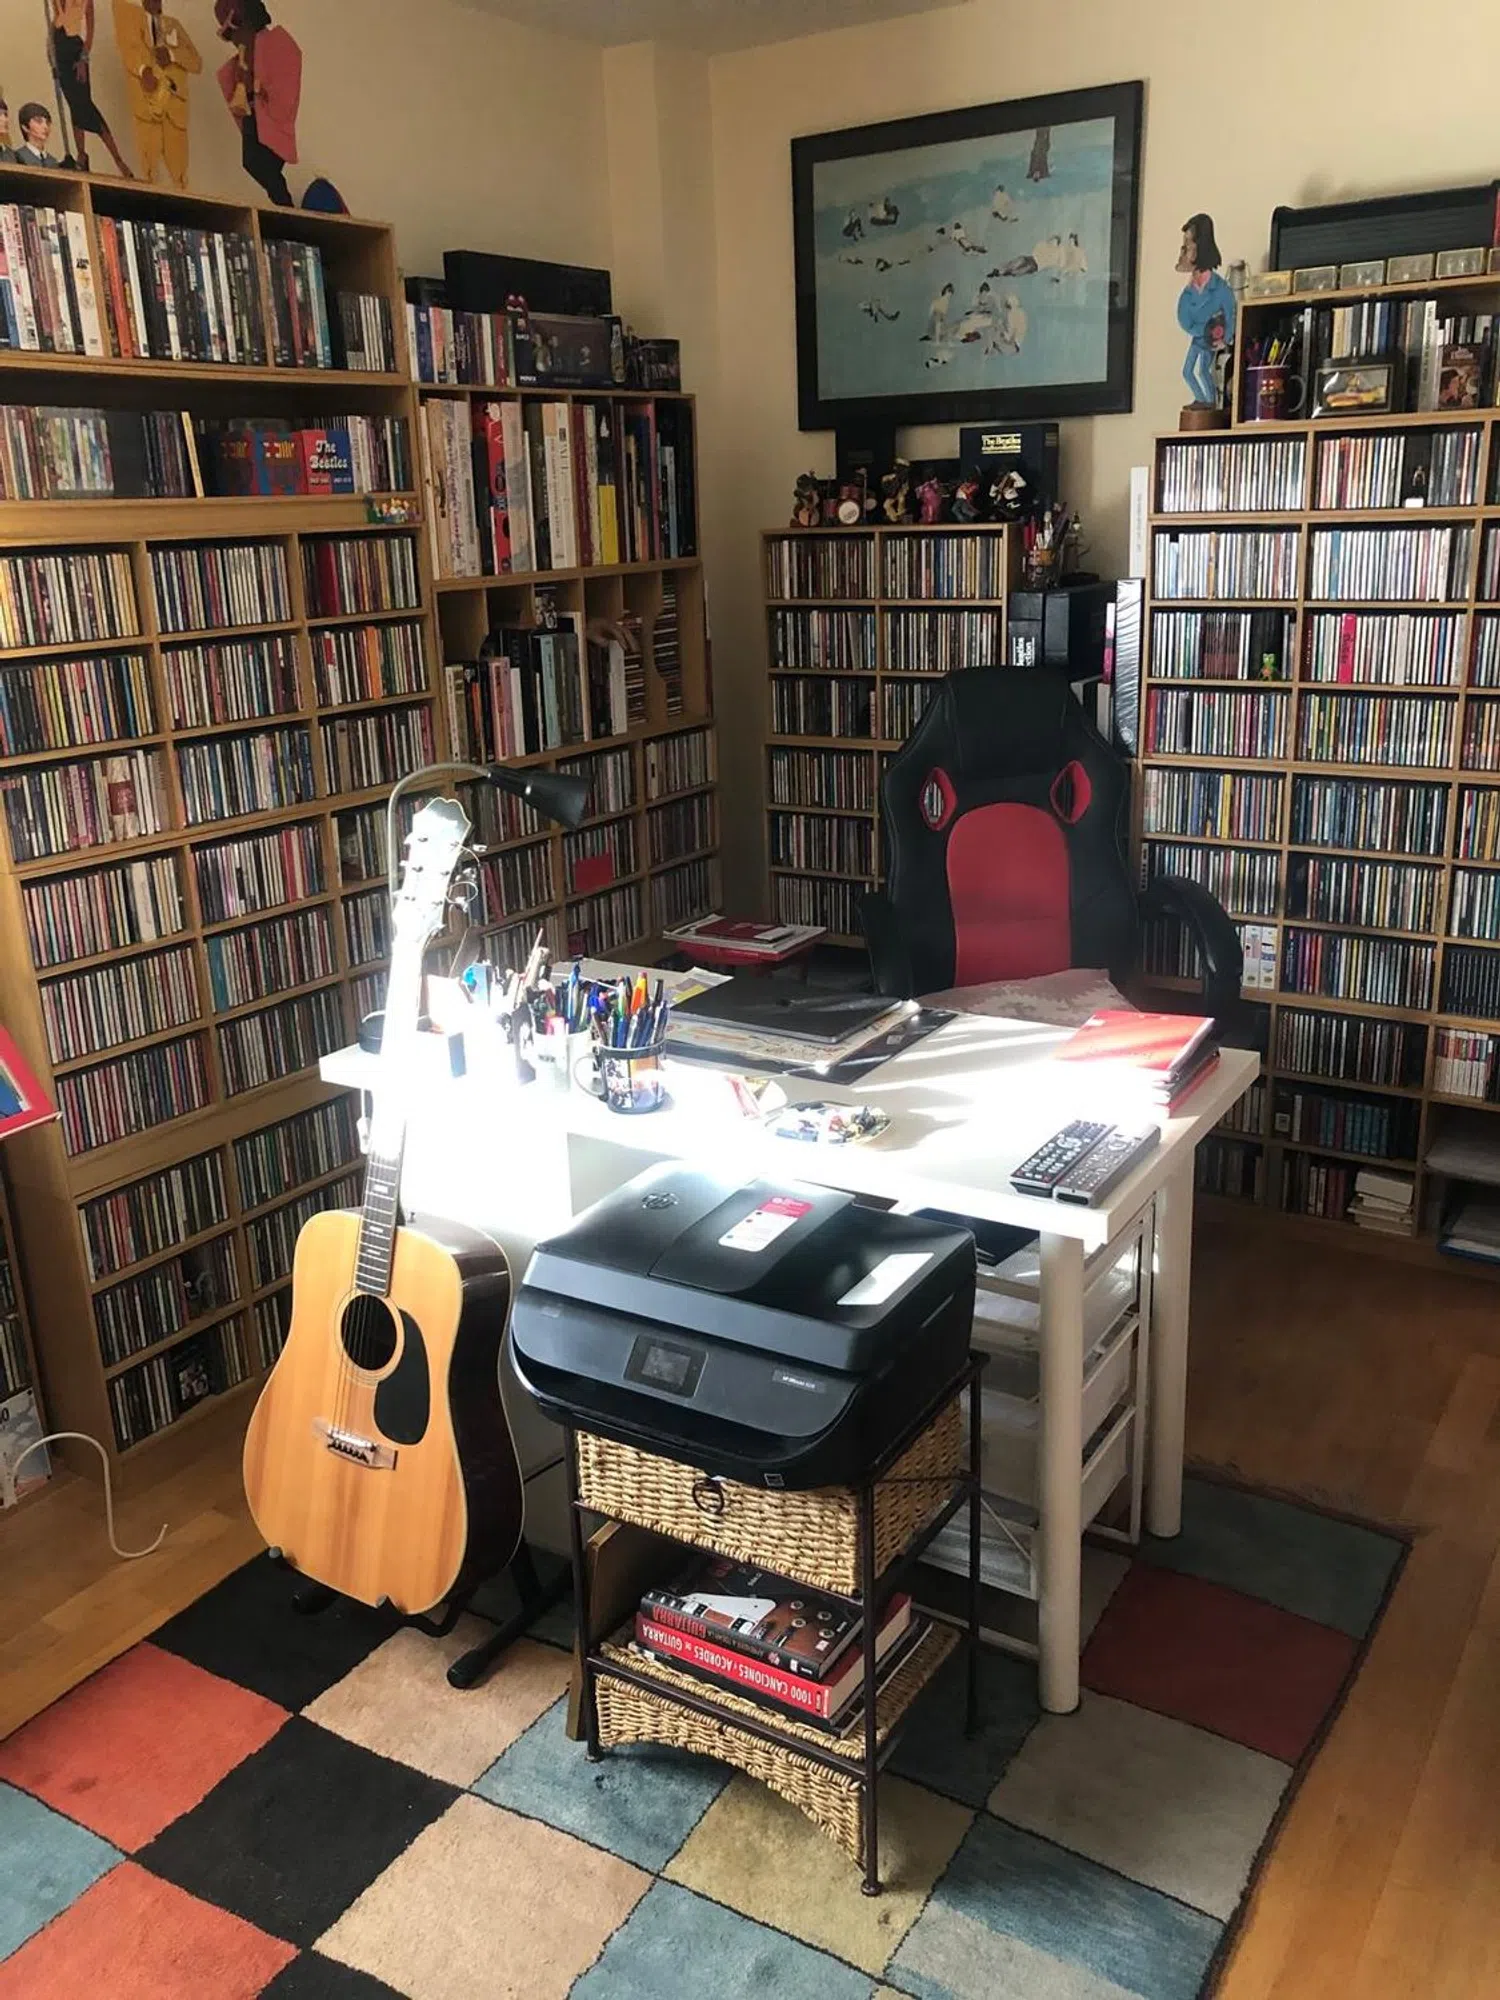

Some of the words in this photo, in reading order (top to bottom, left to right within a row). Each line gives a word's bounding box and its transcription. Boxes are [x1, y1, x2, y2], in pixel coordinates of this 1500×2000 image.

[315, 440, 336, 453] The
[310, 455, 348, 469] Beatles
[653, 1604, 707, 1638] GUITARRA
[642, 1624, 683, 1651] GUITARRA
[694, 1645, 734, 1672] ACORDES
[738, 1663, 788, 1695] CANCIONES
[790, 1685, 812, 1705] 1000
